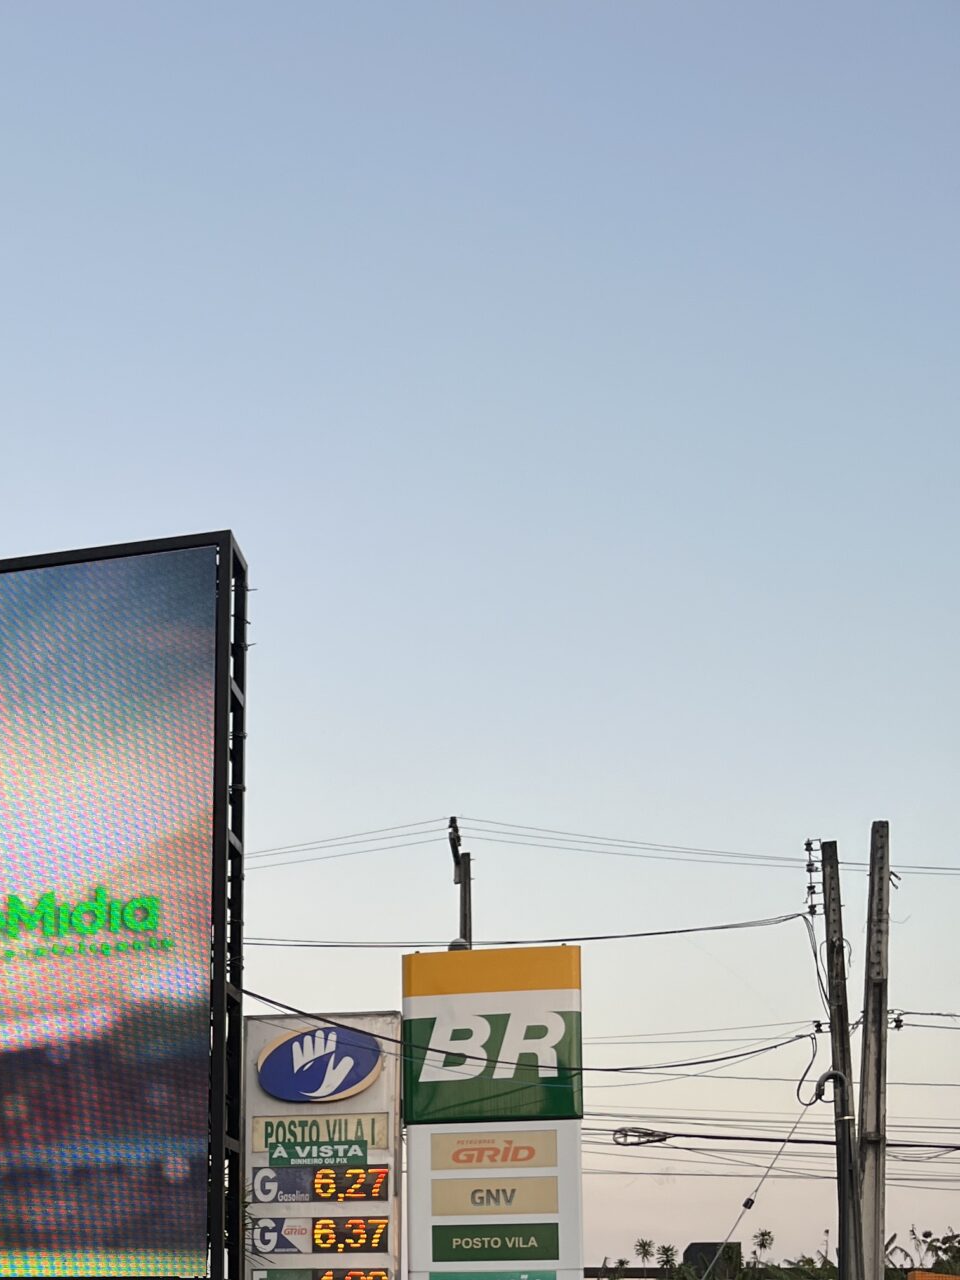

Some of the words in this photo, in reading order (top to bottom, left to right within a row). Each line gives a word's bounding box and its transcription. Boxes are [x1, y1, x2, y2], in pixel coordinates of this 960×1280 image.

[419, 1010, 566, 1083] BR
[264, 1119, 320, 1148] POSTO
[326, 1118, 365, 1142] VILA
[272, 1144, 288, 1158] À
[295, 1144, 364, 1158] VISTA
[451, 1140, 536, 1164] GRID
[253, 1167, 278, 1202] G
[277, 1190, 310, 1202] Gasolina
[314, 1168, 389, 1202] 6,27
[470, 1188, 517, 1206] GNV
[253, 1218, 278, 1253] G
[314, 1219, 389, 1252] 6,37
[452, 1237, 501, 1249] POSTO
[505, 1236, 538, 1248] VILA
